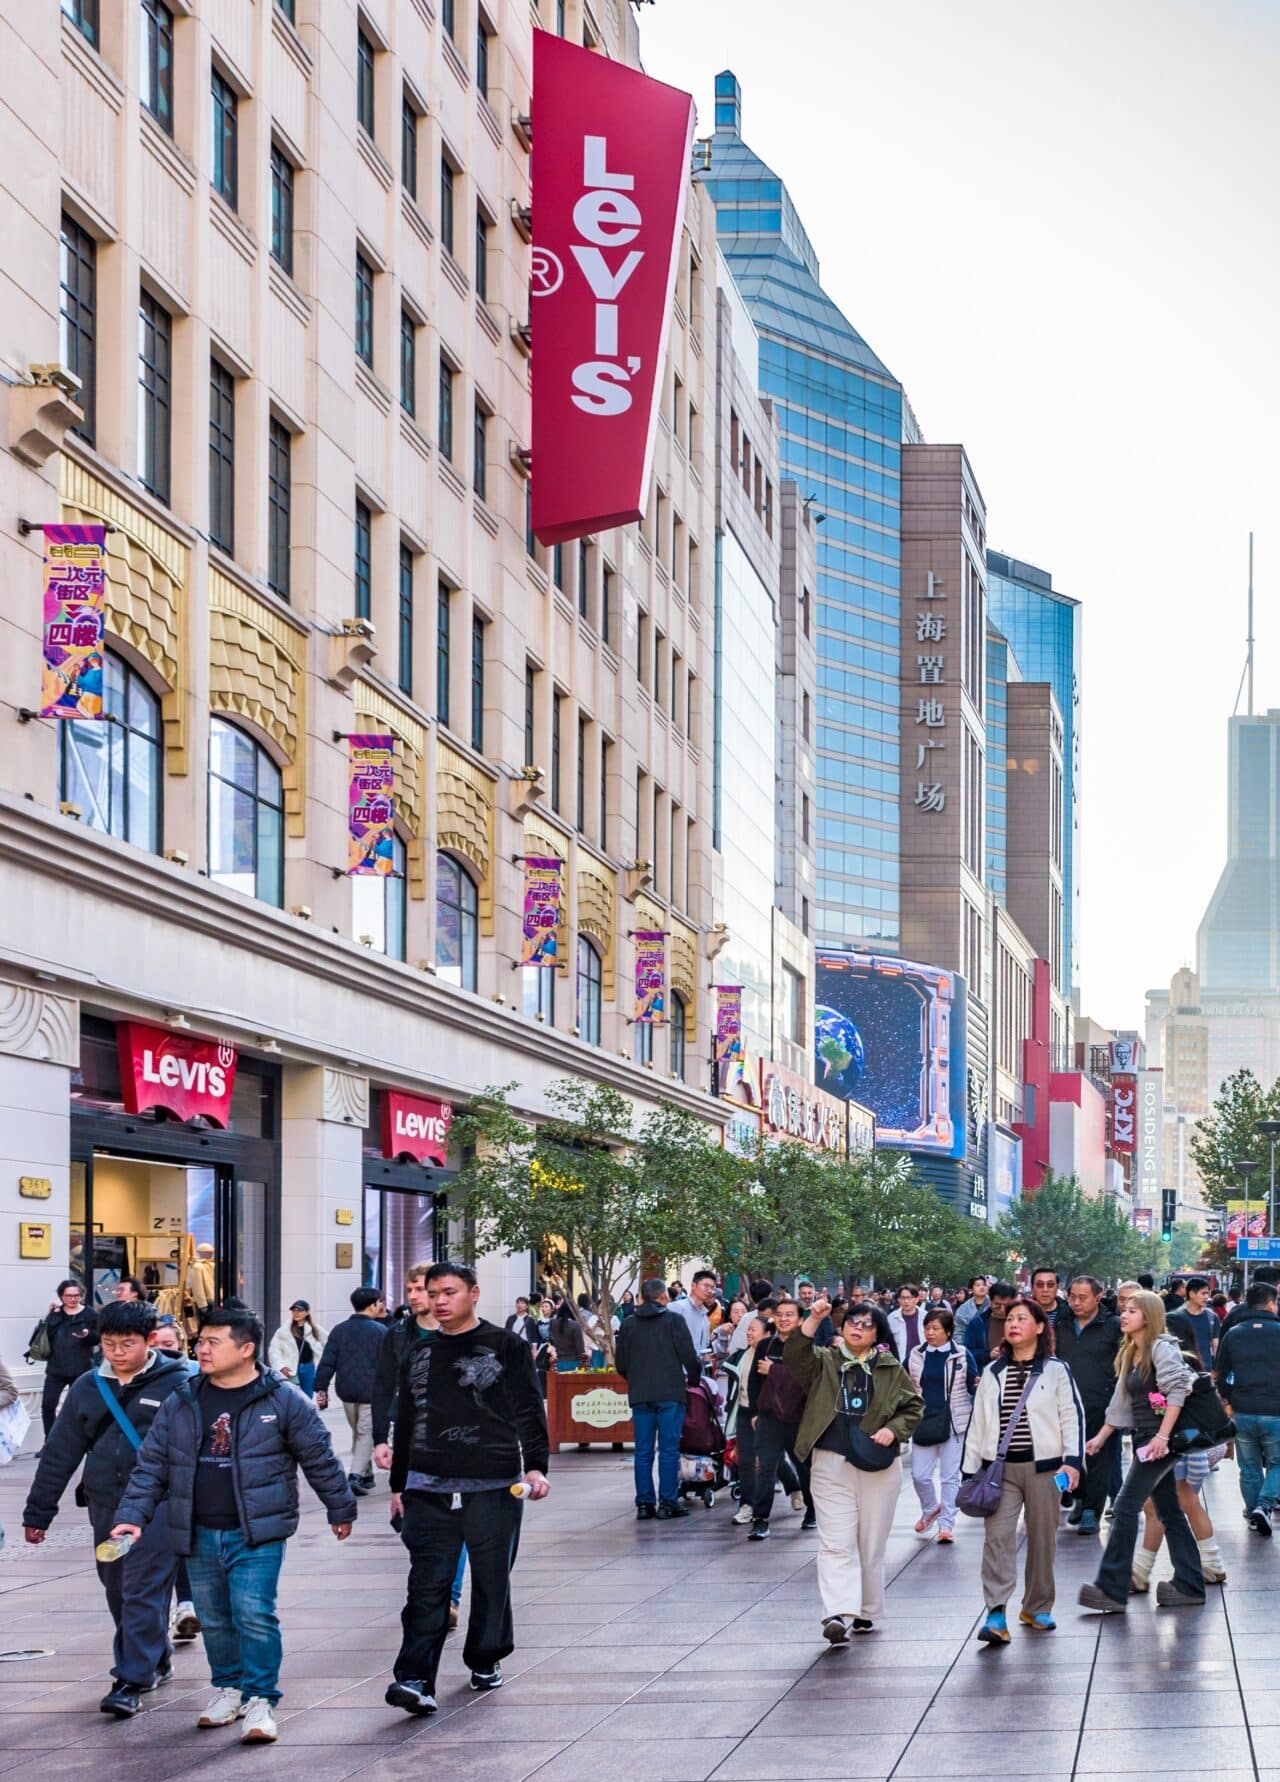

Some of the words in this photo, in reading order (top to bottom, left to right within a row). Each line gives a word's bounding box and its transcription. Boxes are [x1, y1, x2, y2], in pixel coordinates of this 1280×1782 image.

[49, 565, 101, 583] 二次元
[56, 584, 89, 601] 街区
[49, 623, 98, 647] 四楼
[914, 571, 947, 813] 上海置地广场
[354, 765, 391, 777] 二次元
[353, 807, 388, 823] 四楼
[1114, 1089, 1135, 1144] KFC
[1144, 1081, 1156, 1171] BOSIDENG
